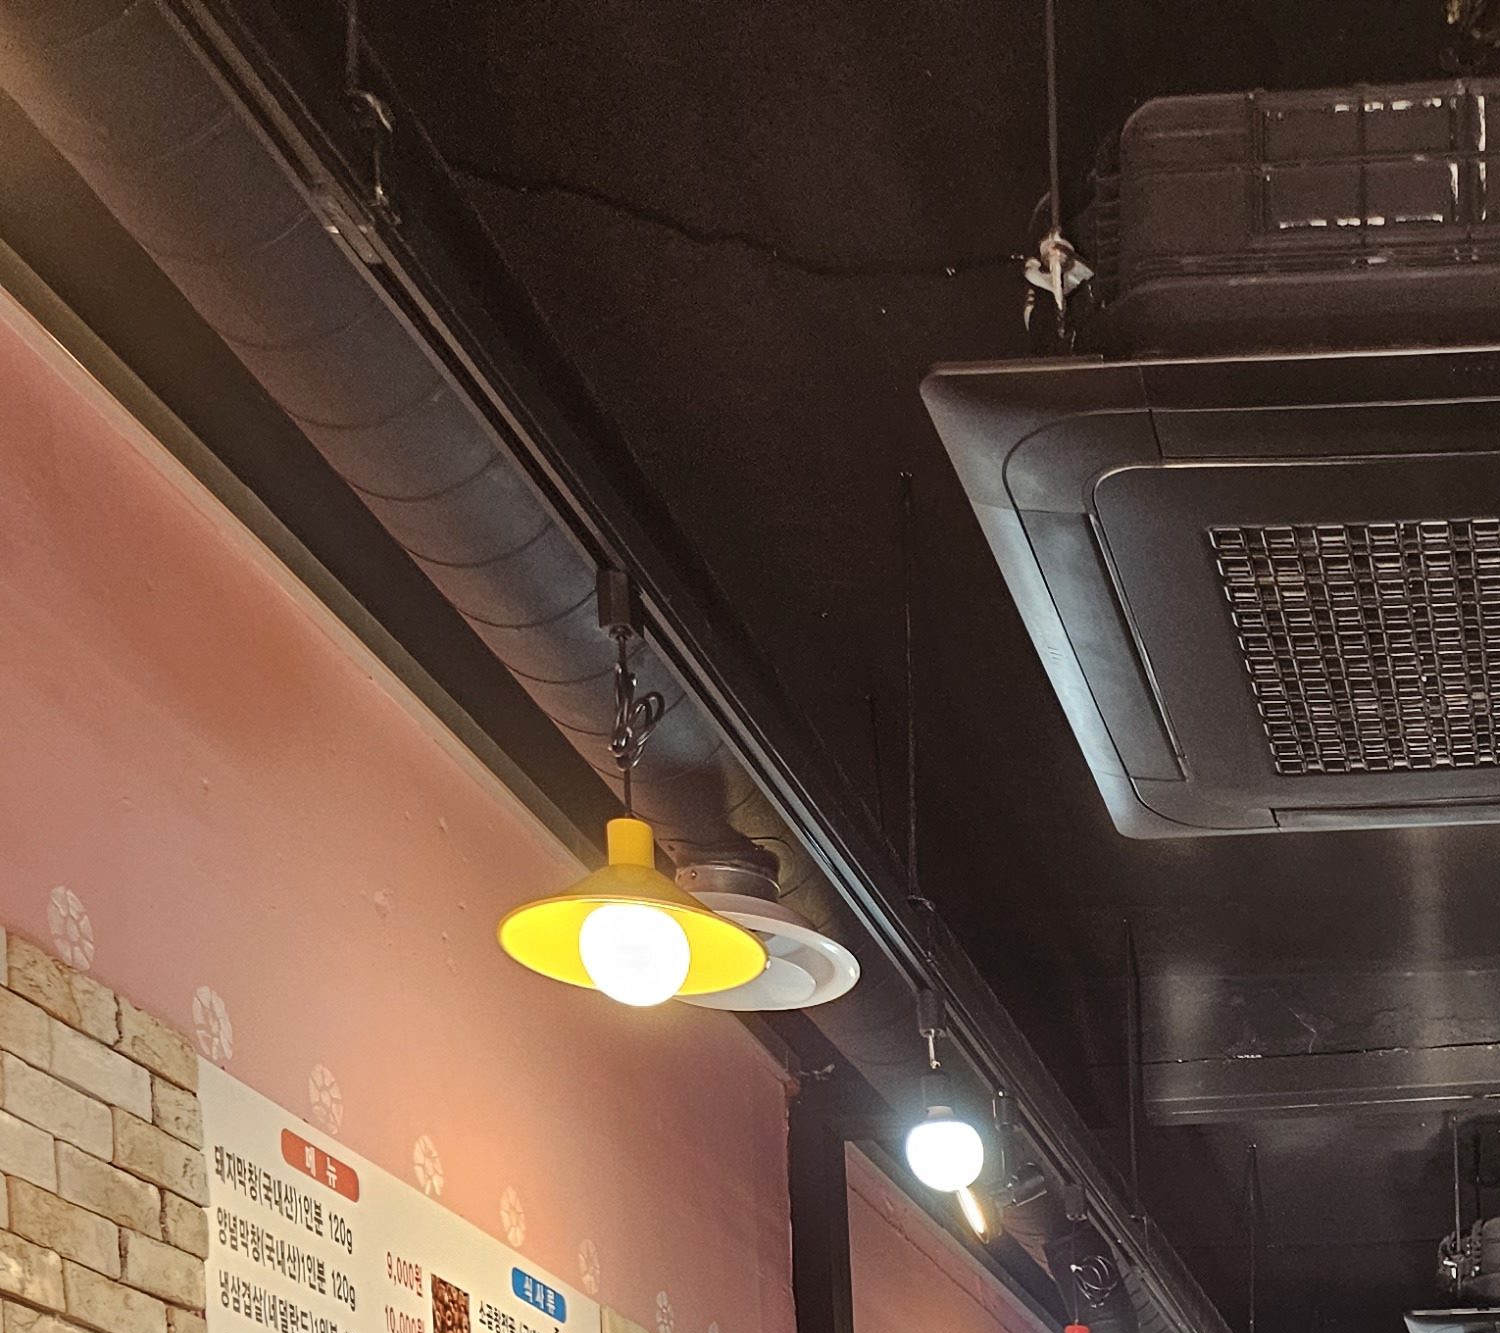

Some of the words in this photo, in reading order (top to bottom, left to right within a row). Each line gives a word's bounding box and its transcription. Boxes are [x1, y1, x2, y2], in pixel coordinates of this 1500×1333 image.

[328, 1209, 353, 1255] 120g
[331, 1268, 355, 1312] 120g
[385, 1246, 423, 1299] 9,000원
